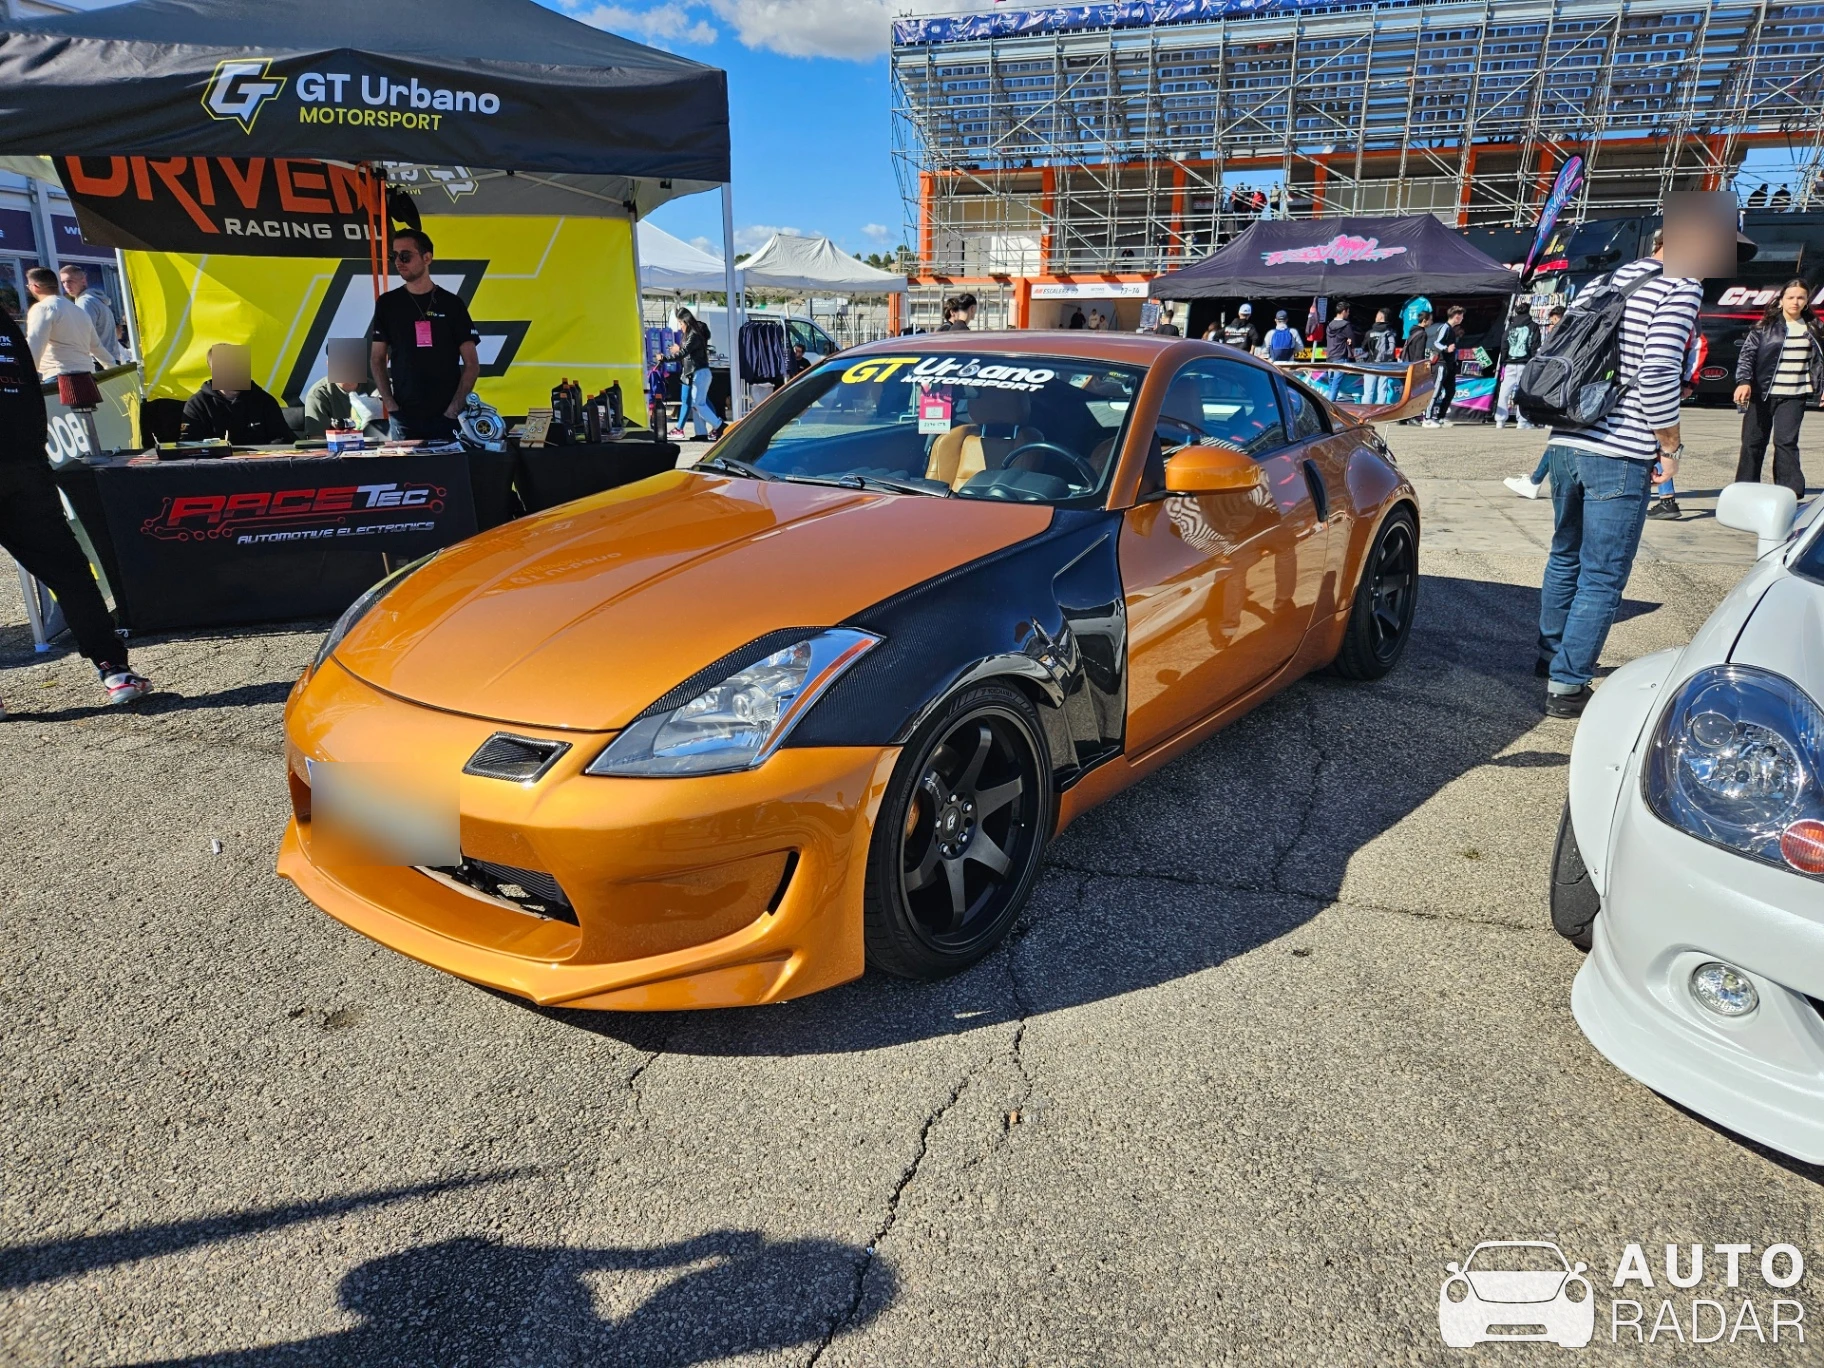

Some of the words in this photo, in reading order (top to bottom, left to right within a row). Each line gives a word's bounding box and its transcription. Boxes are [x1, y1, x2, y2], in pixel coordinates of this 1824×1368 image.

[296, 72, 351, 103] GT
[361, 75, 501, 115] Urbano
[299, 106, 443, 131] MOTORSPORT
[65, 155, 382, 234] DRIVEN
[224, 218, 333, 240] RACING
[841, 357, 922, 384] GT
[913, 356, 1056, 384] Urbano
[900, 374, 1045, 393] MOTORSPORT
[236, 527, 334, 545] AUTOMOTIVE
[336, 521, 435, 538] ELECTRONICS
